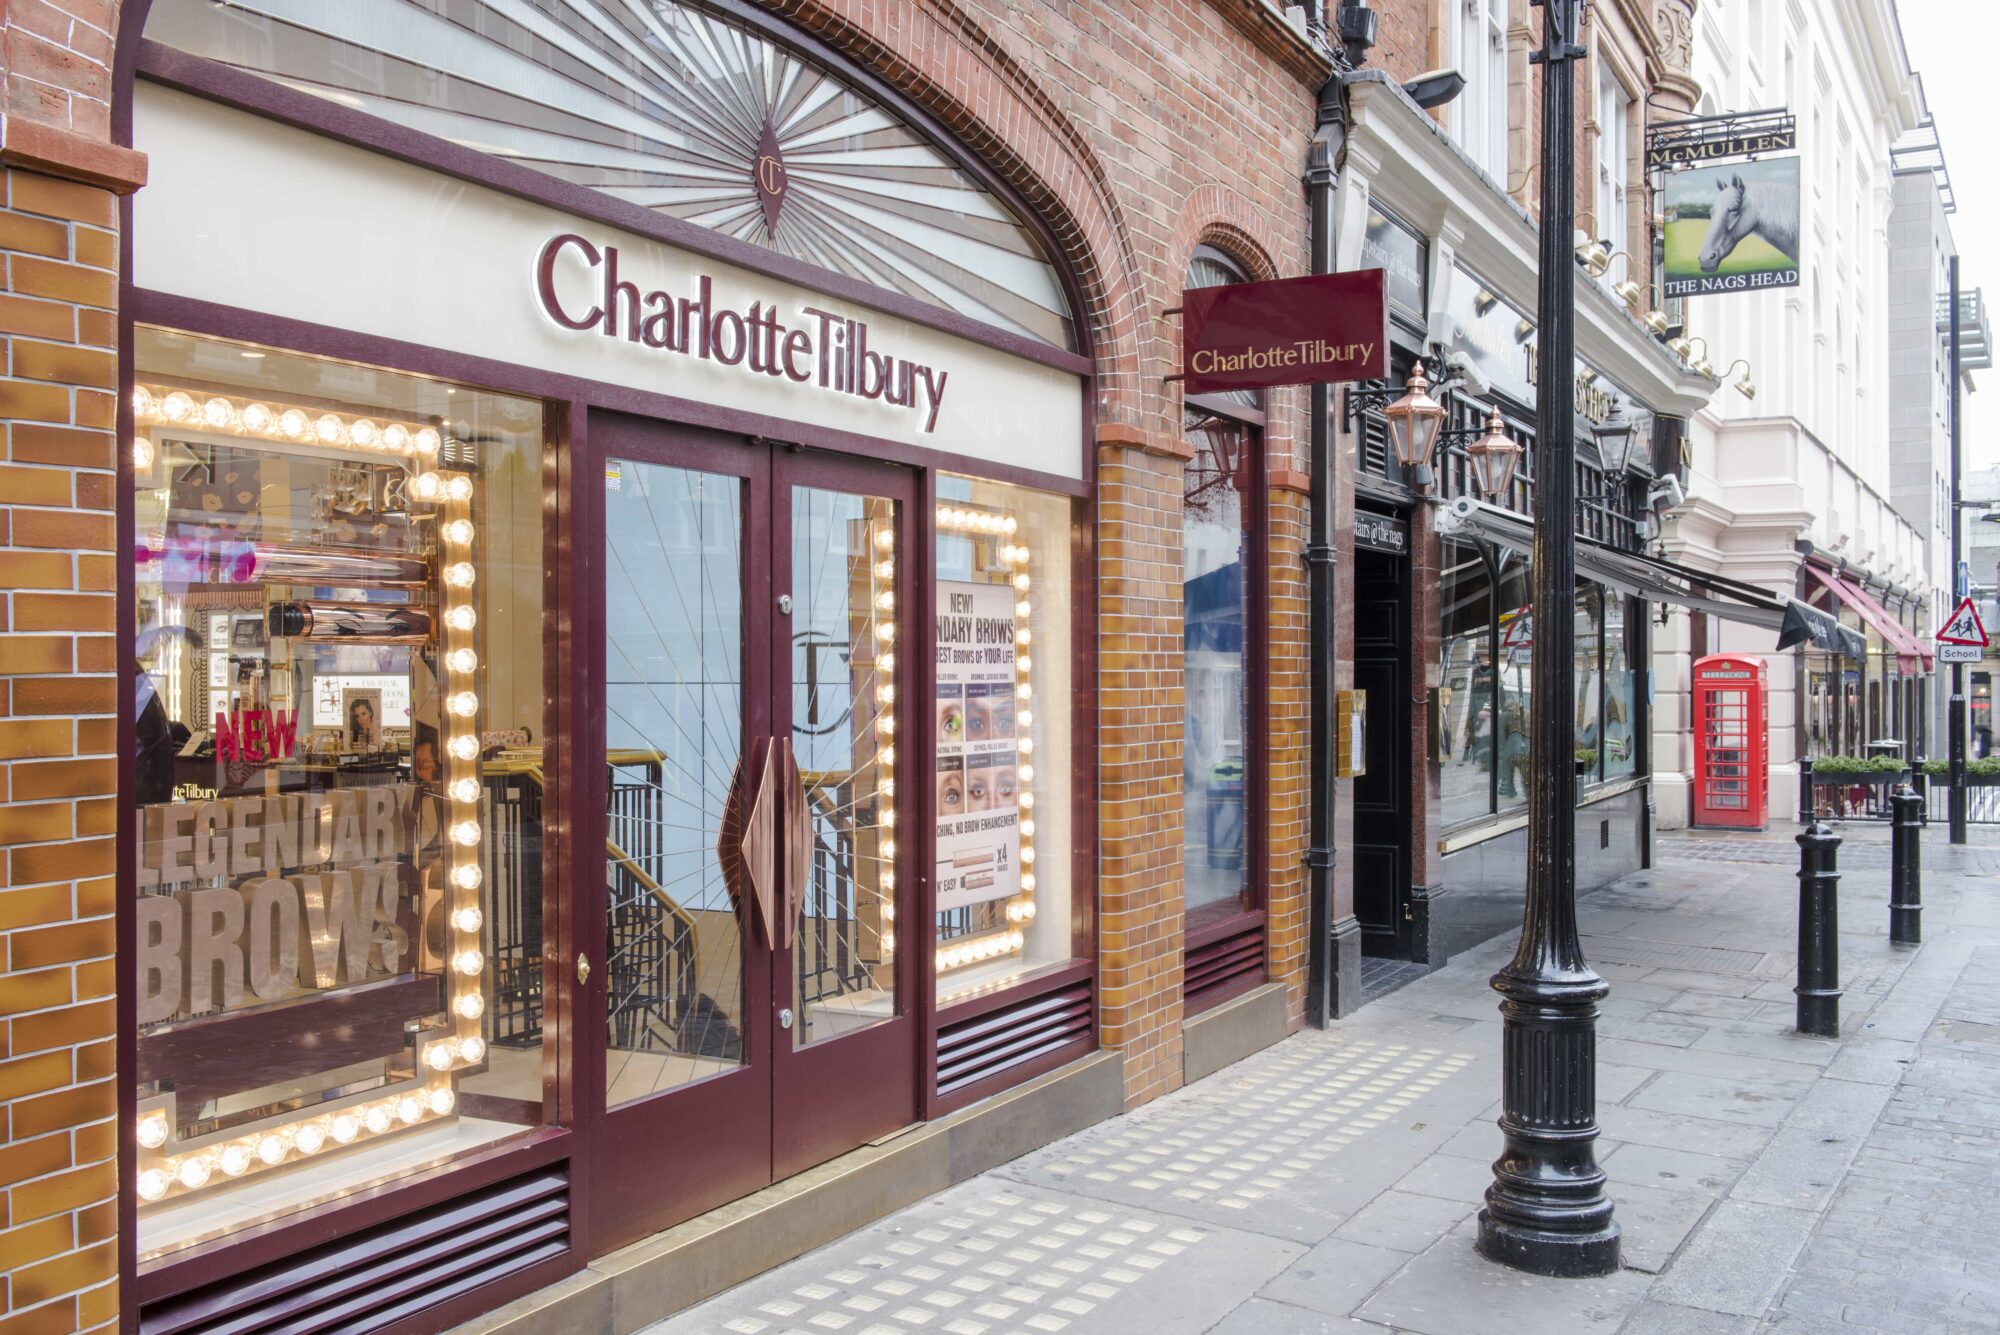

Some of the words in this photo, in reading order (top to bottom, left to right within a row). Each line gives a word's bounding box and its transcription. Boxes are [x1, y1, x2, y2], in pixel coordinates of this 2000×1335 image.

[1650, 134, 1791, 164] McMULLEN
[1665, 279, 1697, 294] THE
[1700, 274, 1746, 292] NAGS
[1751, 270, 1797, 287] HEAD
[534, 233, 948, 433] CharlotteTilbury
[1191, 340, 1374, 374] CharlotteTilbury
[1378, 521, 1389, 542] the
[1389, 529, 1404, 550] nags
[950, 592, 973, 614] NEW!
[936, 615, 972, 643] NDARY
[976, 617, 1014, 644] BROWS
[953, 649, 975, 664] BROWS
[975, 650, 983, 664] OF
[984, 647, 1002, 664] YOUR
[1002, 650, 1014, 664] LIFE
[1944, 649, 1978, 658] School
[1702, 671, 1750, 679] TELEPHONE
[216, 709, 299, 764] NEW
[136, 784, 420, 885] LEGENDARY
[956, 821, 963, 834] NO
[964, 820, 980, 834] BROW
[981, 813, 1018, 831] ENHANCEMENT
[943, 878, 957, 891] EASY
[136, 862, 419, 1025] BROWS
